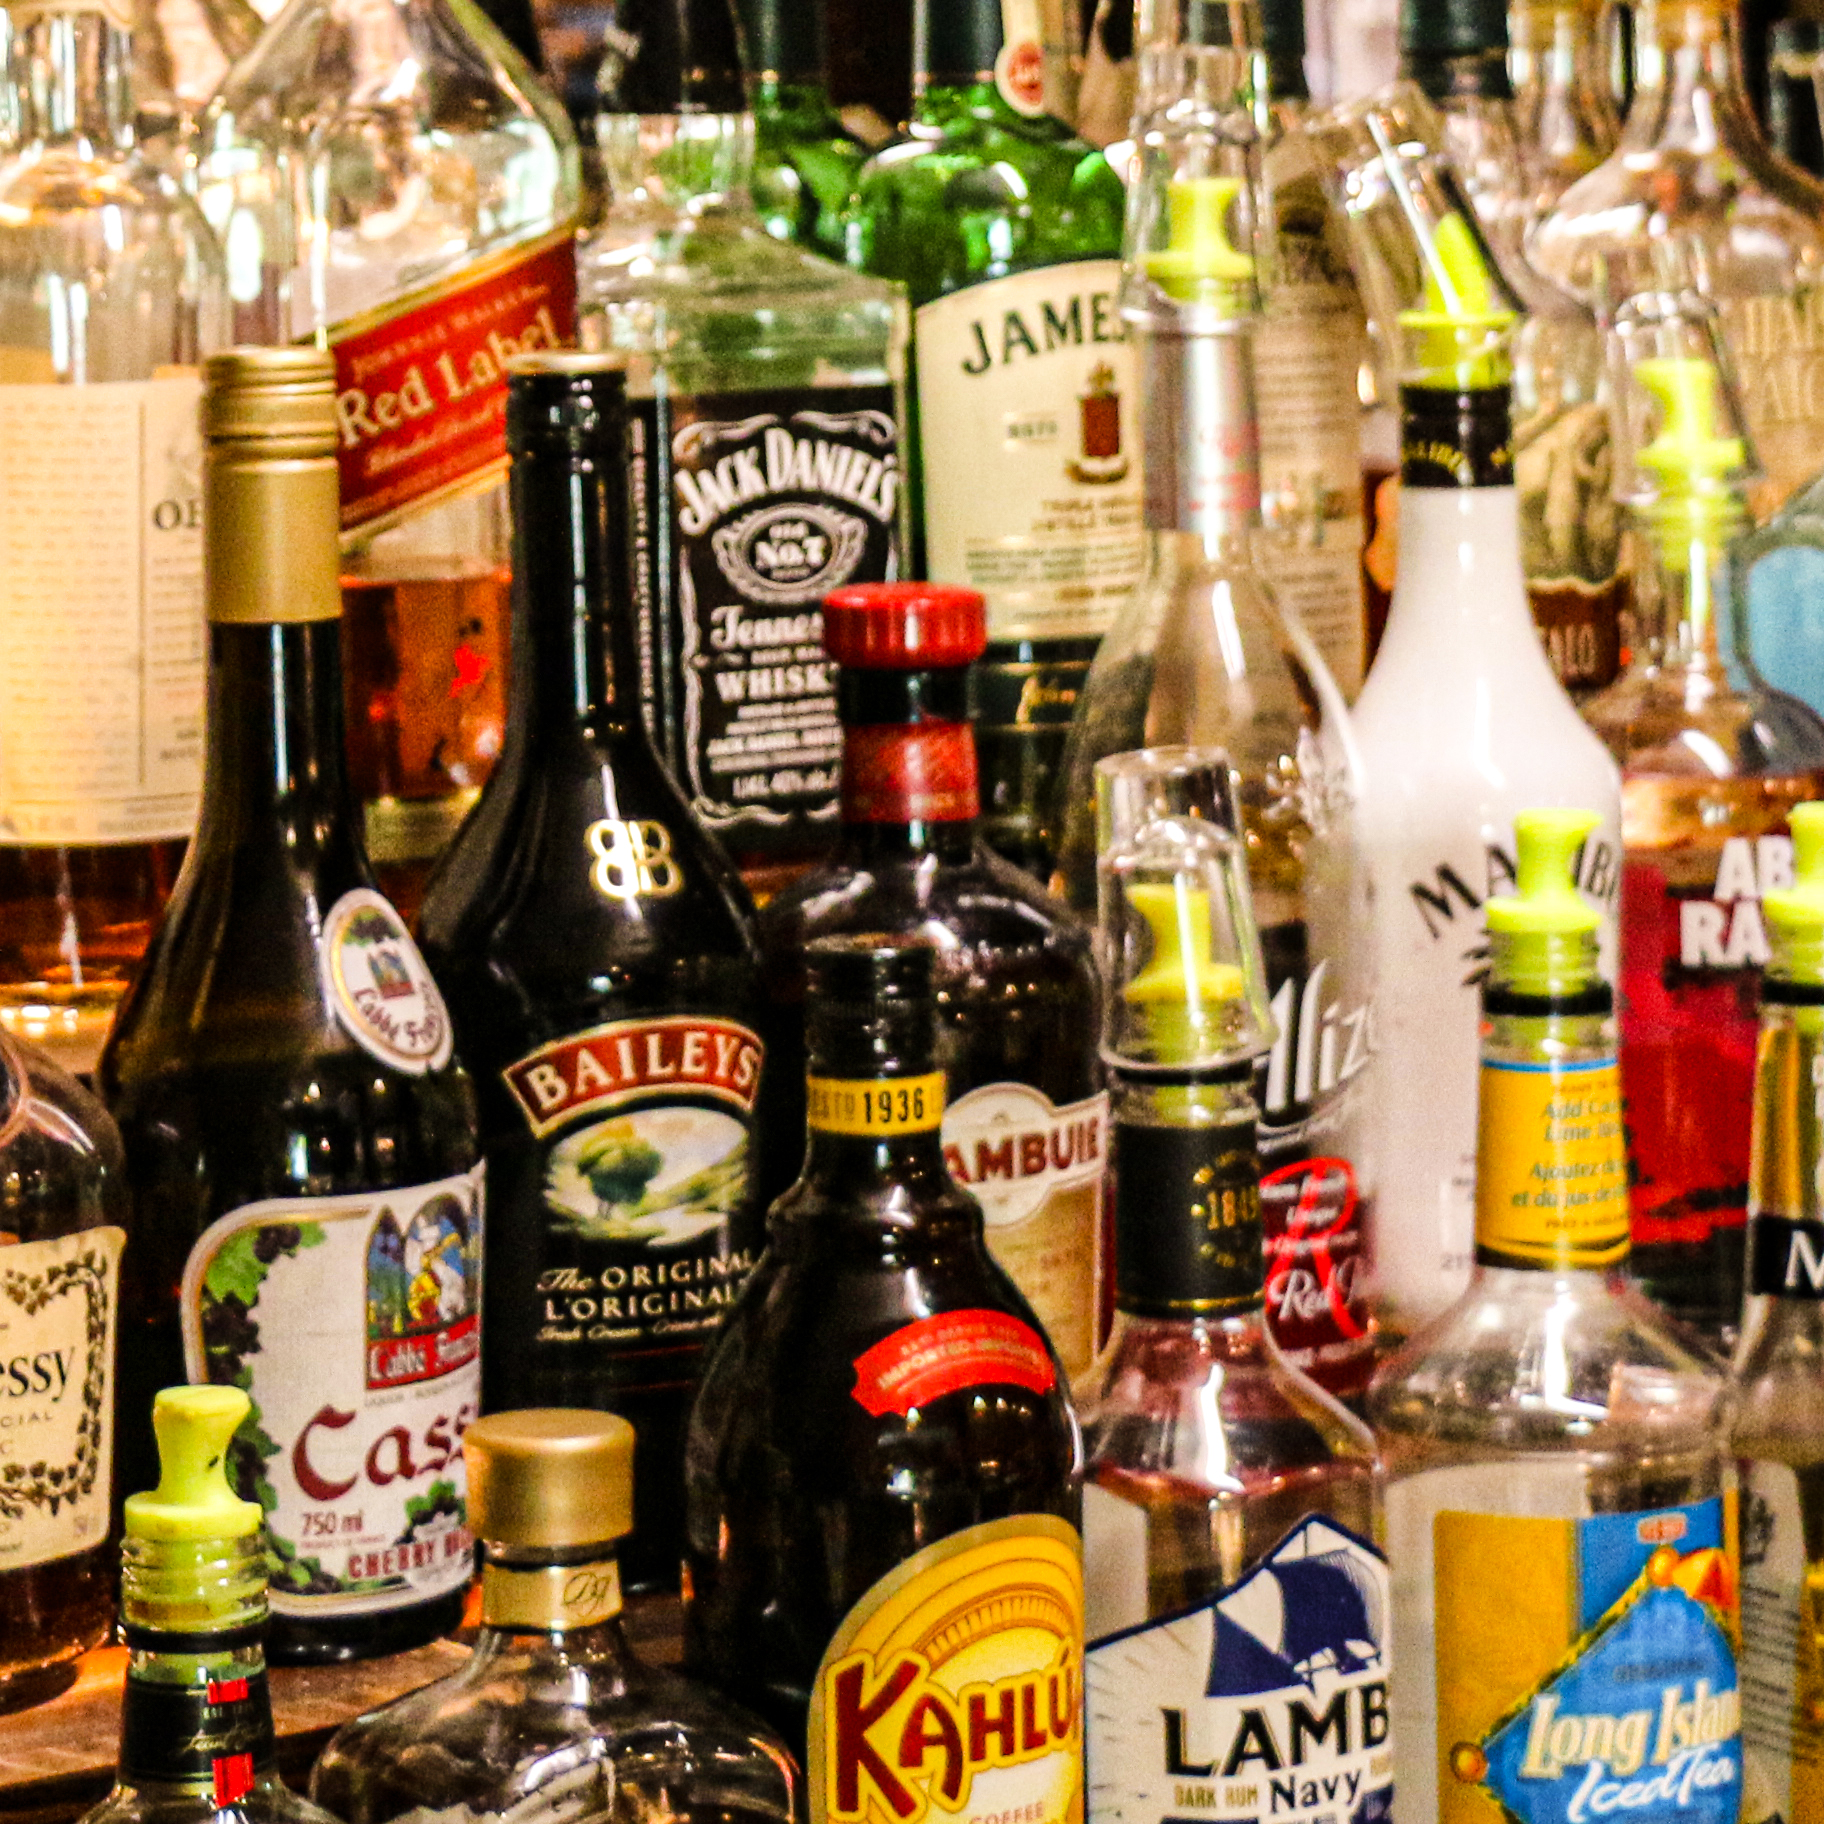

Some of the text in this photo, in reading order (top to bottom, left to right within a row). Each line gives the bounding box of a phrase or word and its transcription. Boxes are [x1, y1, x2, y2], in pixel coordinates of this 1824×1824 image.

[961, 291, 1125, 375] JAME
[337, 365, 437, 448] Red
[436, 305, 561, 402] Label
[674, 446, 768, 536] JACK
[1681, 900, 1773, 966] RA
[527, 1030, 755, 1111] BAILEYS
[863, 1087, 925, 1125] 1936
[943, 1116, 1099, 1184] AMBUIE
[537, 1248, 753, 1292] The ORIGINAL
[291, 1403, 478, 1502] Cass
[302, 1512, 337, 1536] 750
[347, 1540, 435, 1579] CHERRY
[835, 1645, 1074, 1819] KAHLÚ
[1519, 1692, 1653, 1780] Long
[1174, 1769, 1362, 1814] DARK RUM Navy
[1567, 1740, 1736, 1824] Iced Tea
